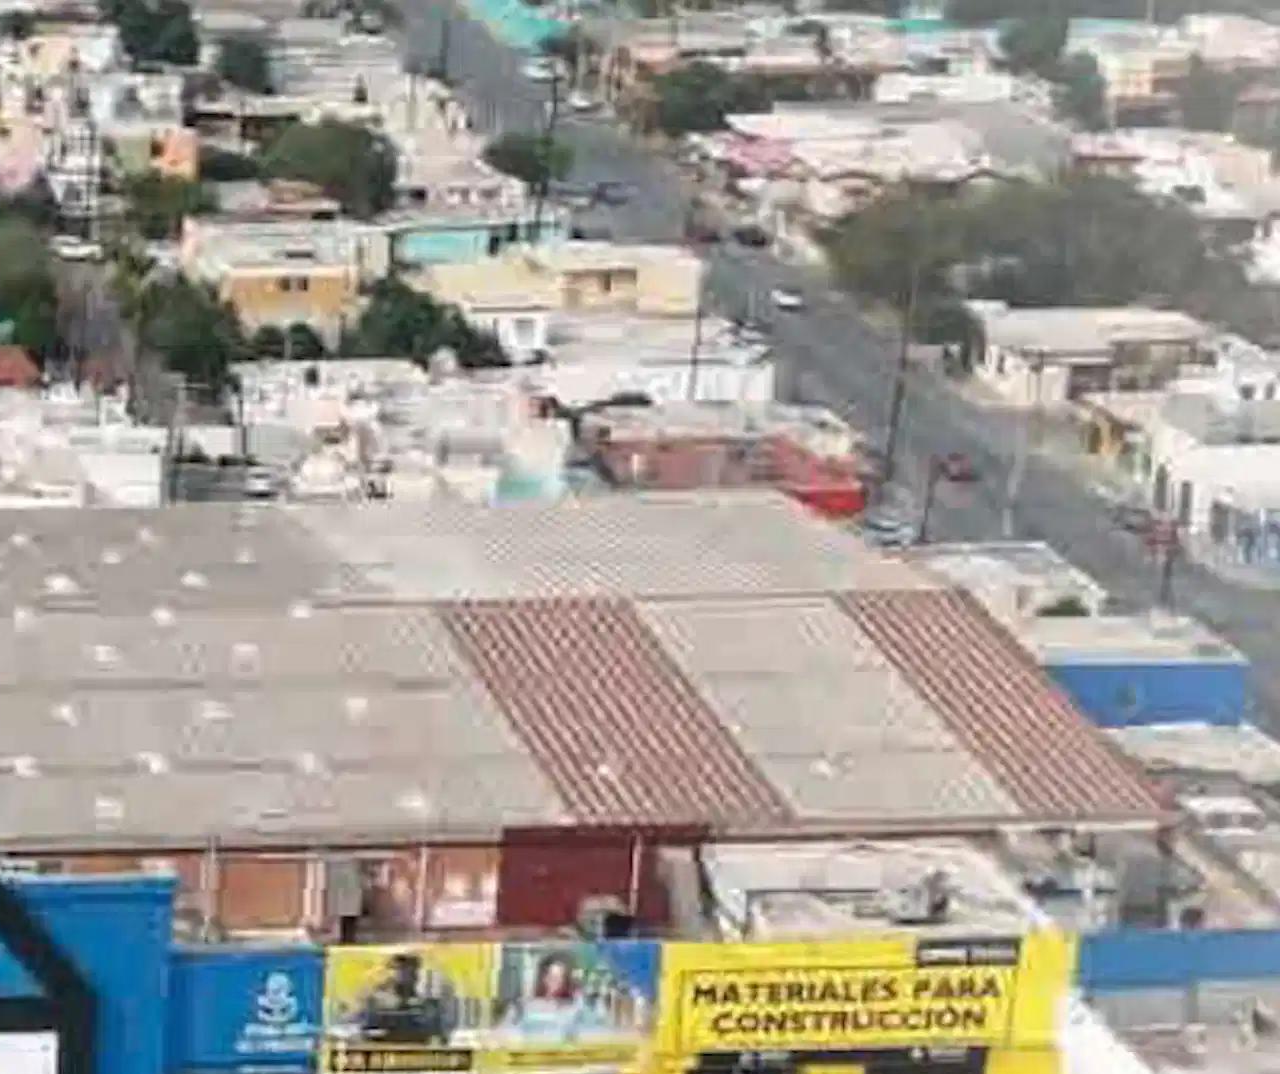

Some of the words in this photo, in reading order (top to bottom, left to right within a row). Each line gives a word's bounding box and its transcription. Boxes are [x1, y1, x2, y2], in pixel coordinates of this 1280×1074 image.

[693, 977, 898, 1004] MATERIALES
[913, 974, 1002, 999] PARA
[712, 1004, 987, 1033] CONSTRUCCIÓN
